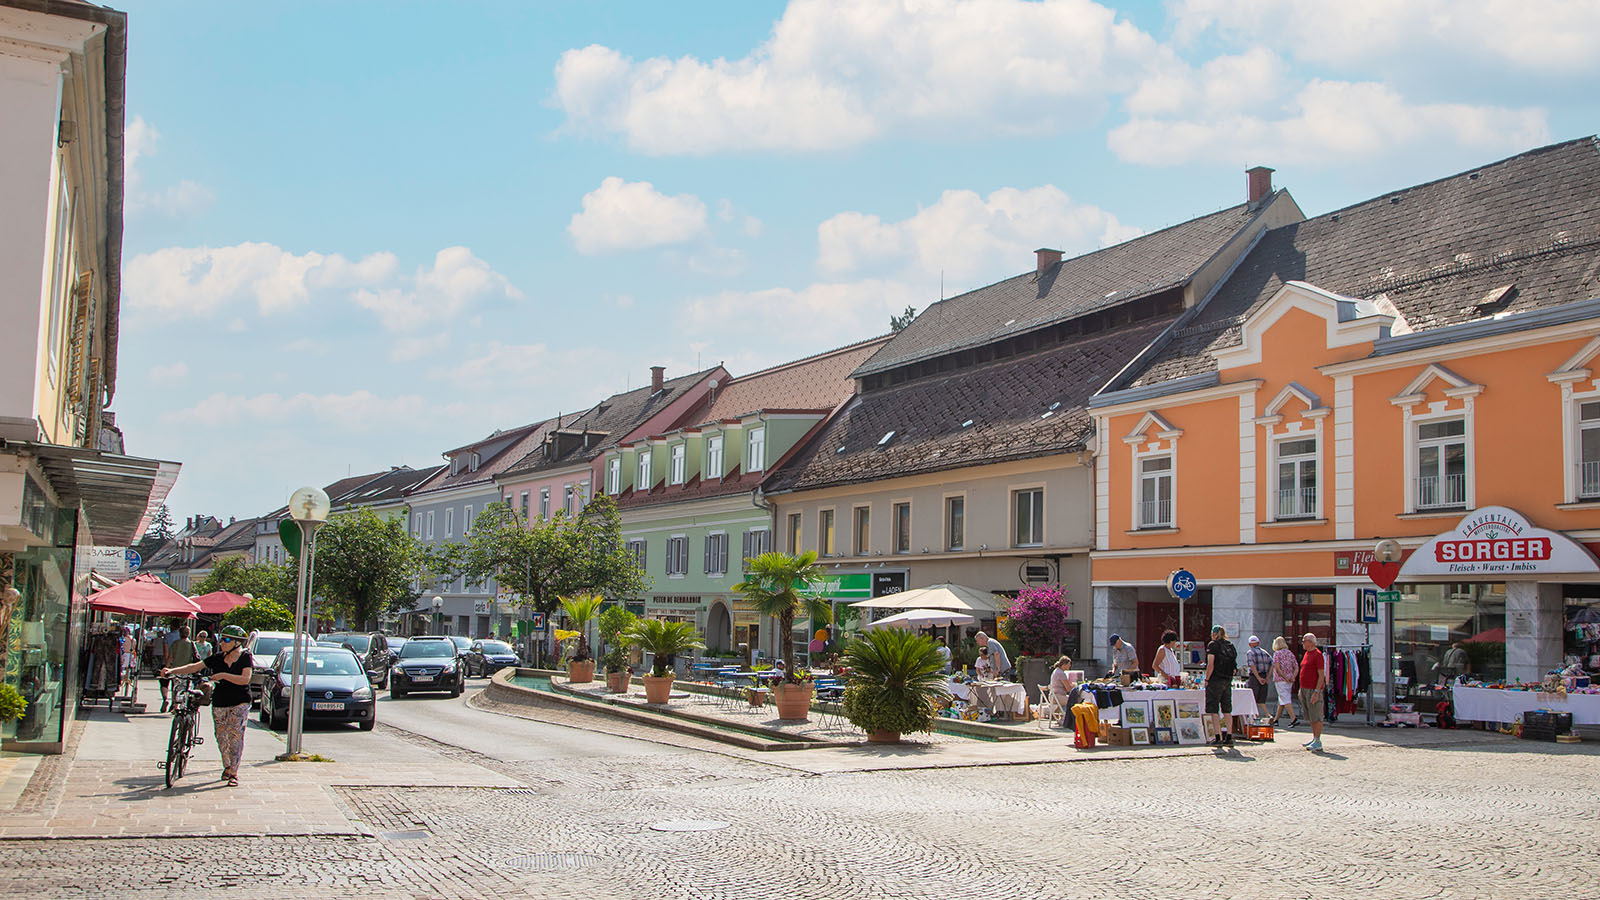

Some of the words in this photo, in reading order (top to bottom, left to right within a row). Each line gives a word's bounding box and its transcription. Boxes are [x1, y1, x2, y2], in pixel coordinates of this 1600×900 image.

[1462, 514, 1523, 536] FRAUENTALER
[1442, 540, 1544, 560] SORGER
[1353, 551, 1376, 563] Flei
[1449, 563, 1476, 572] Fleisch
[1482, 563, 1505, 571] Wurst
[1511, 562, 1537, 571] Imbiss
[885, 586, 902, 594] LADEN
